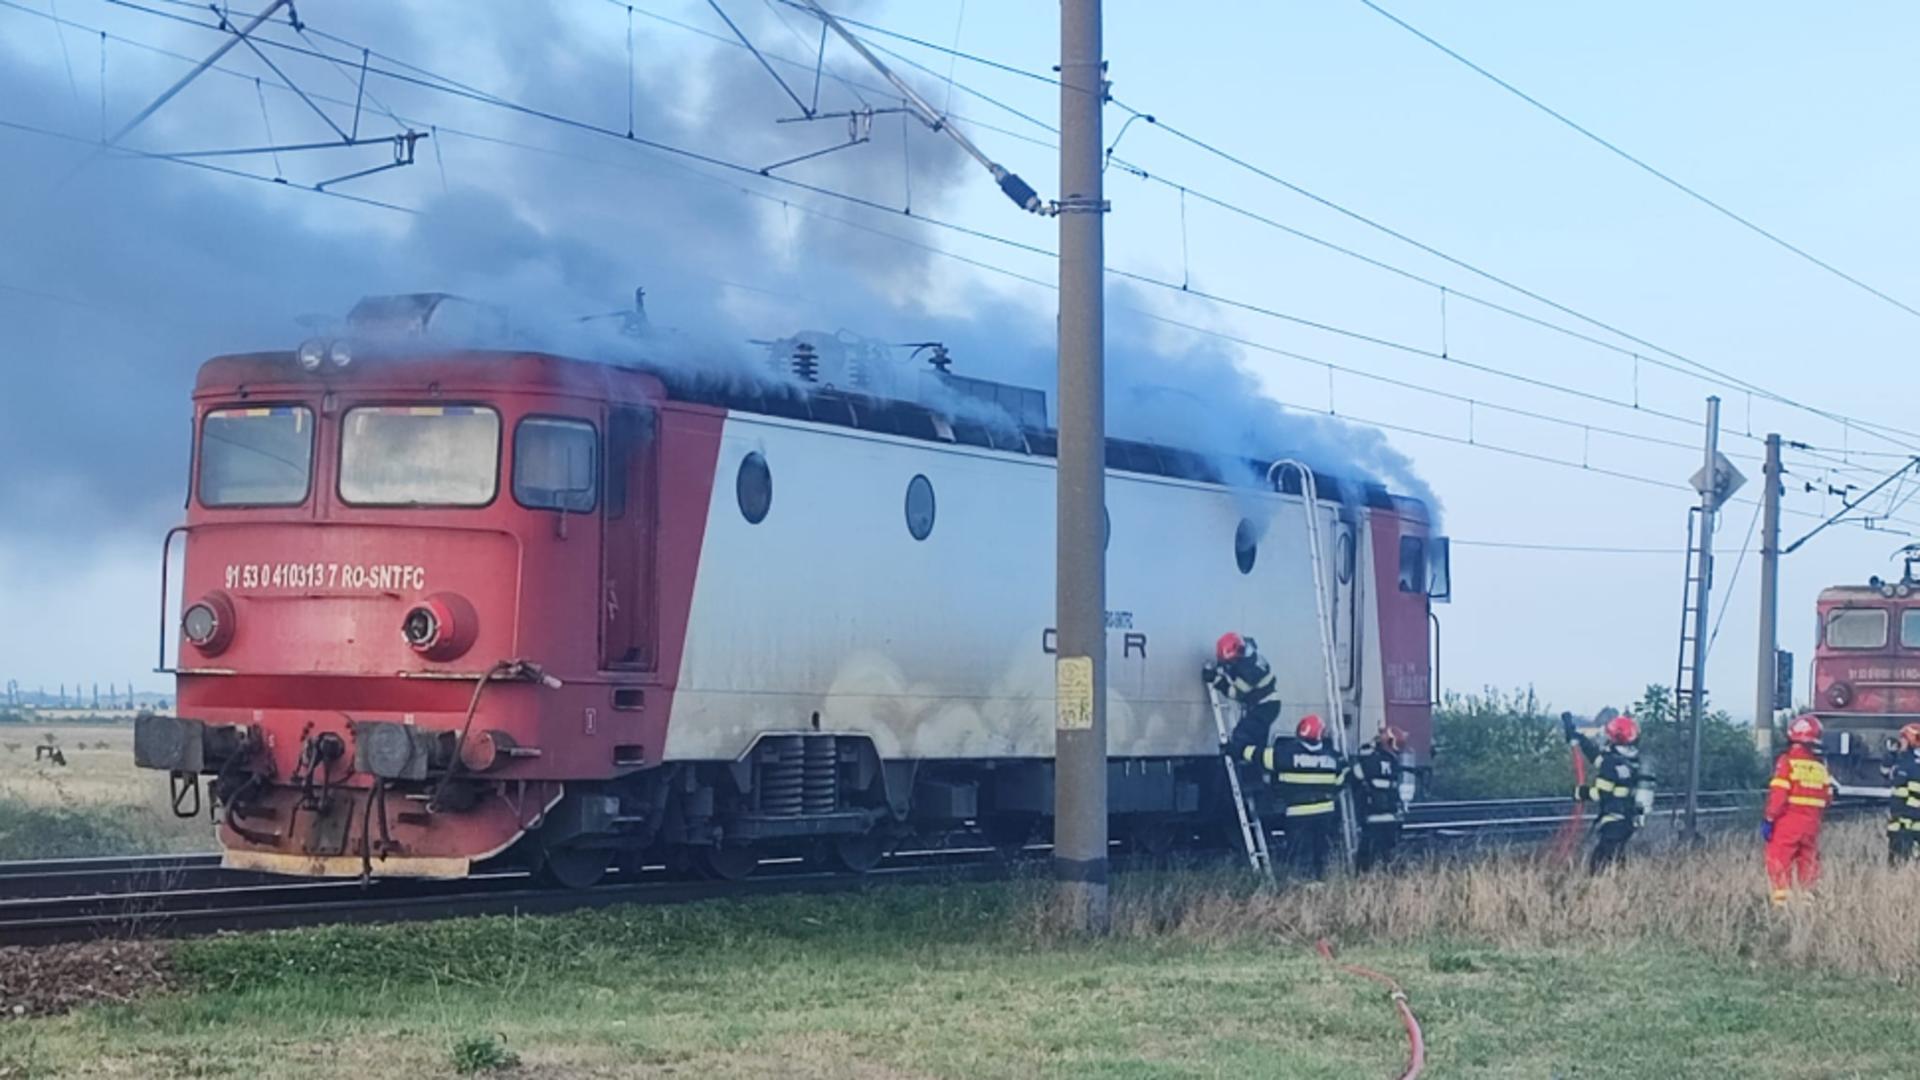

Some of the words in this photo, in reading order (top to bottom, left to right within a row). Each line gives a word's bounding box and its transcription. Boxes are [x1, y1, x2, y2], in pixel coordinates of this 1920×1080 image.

[225, 565, 240, 589] 91
[243, 564, 258, 588] 53
[261, 564, 270, 587] 0
[272, 563, 323, 588] 410313
[328, 563, 338, 588] 7
[341, 564, 425, 590] RO-SNTFC
[1043, 628, 1147, 659] CR
